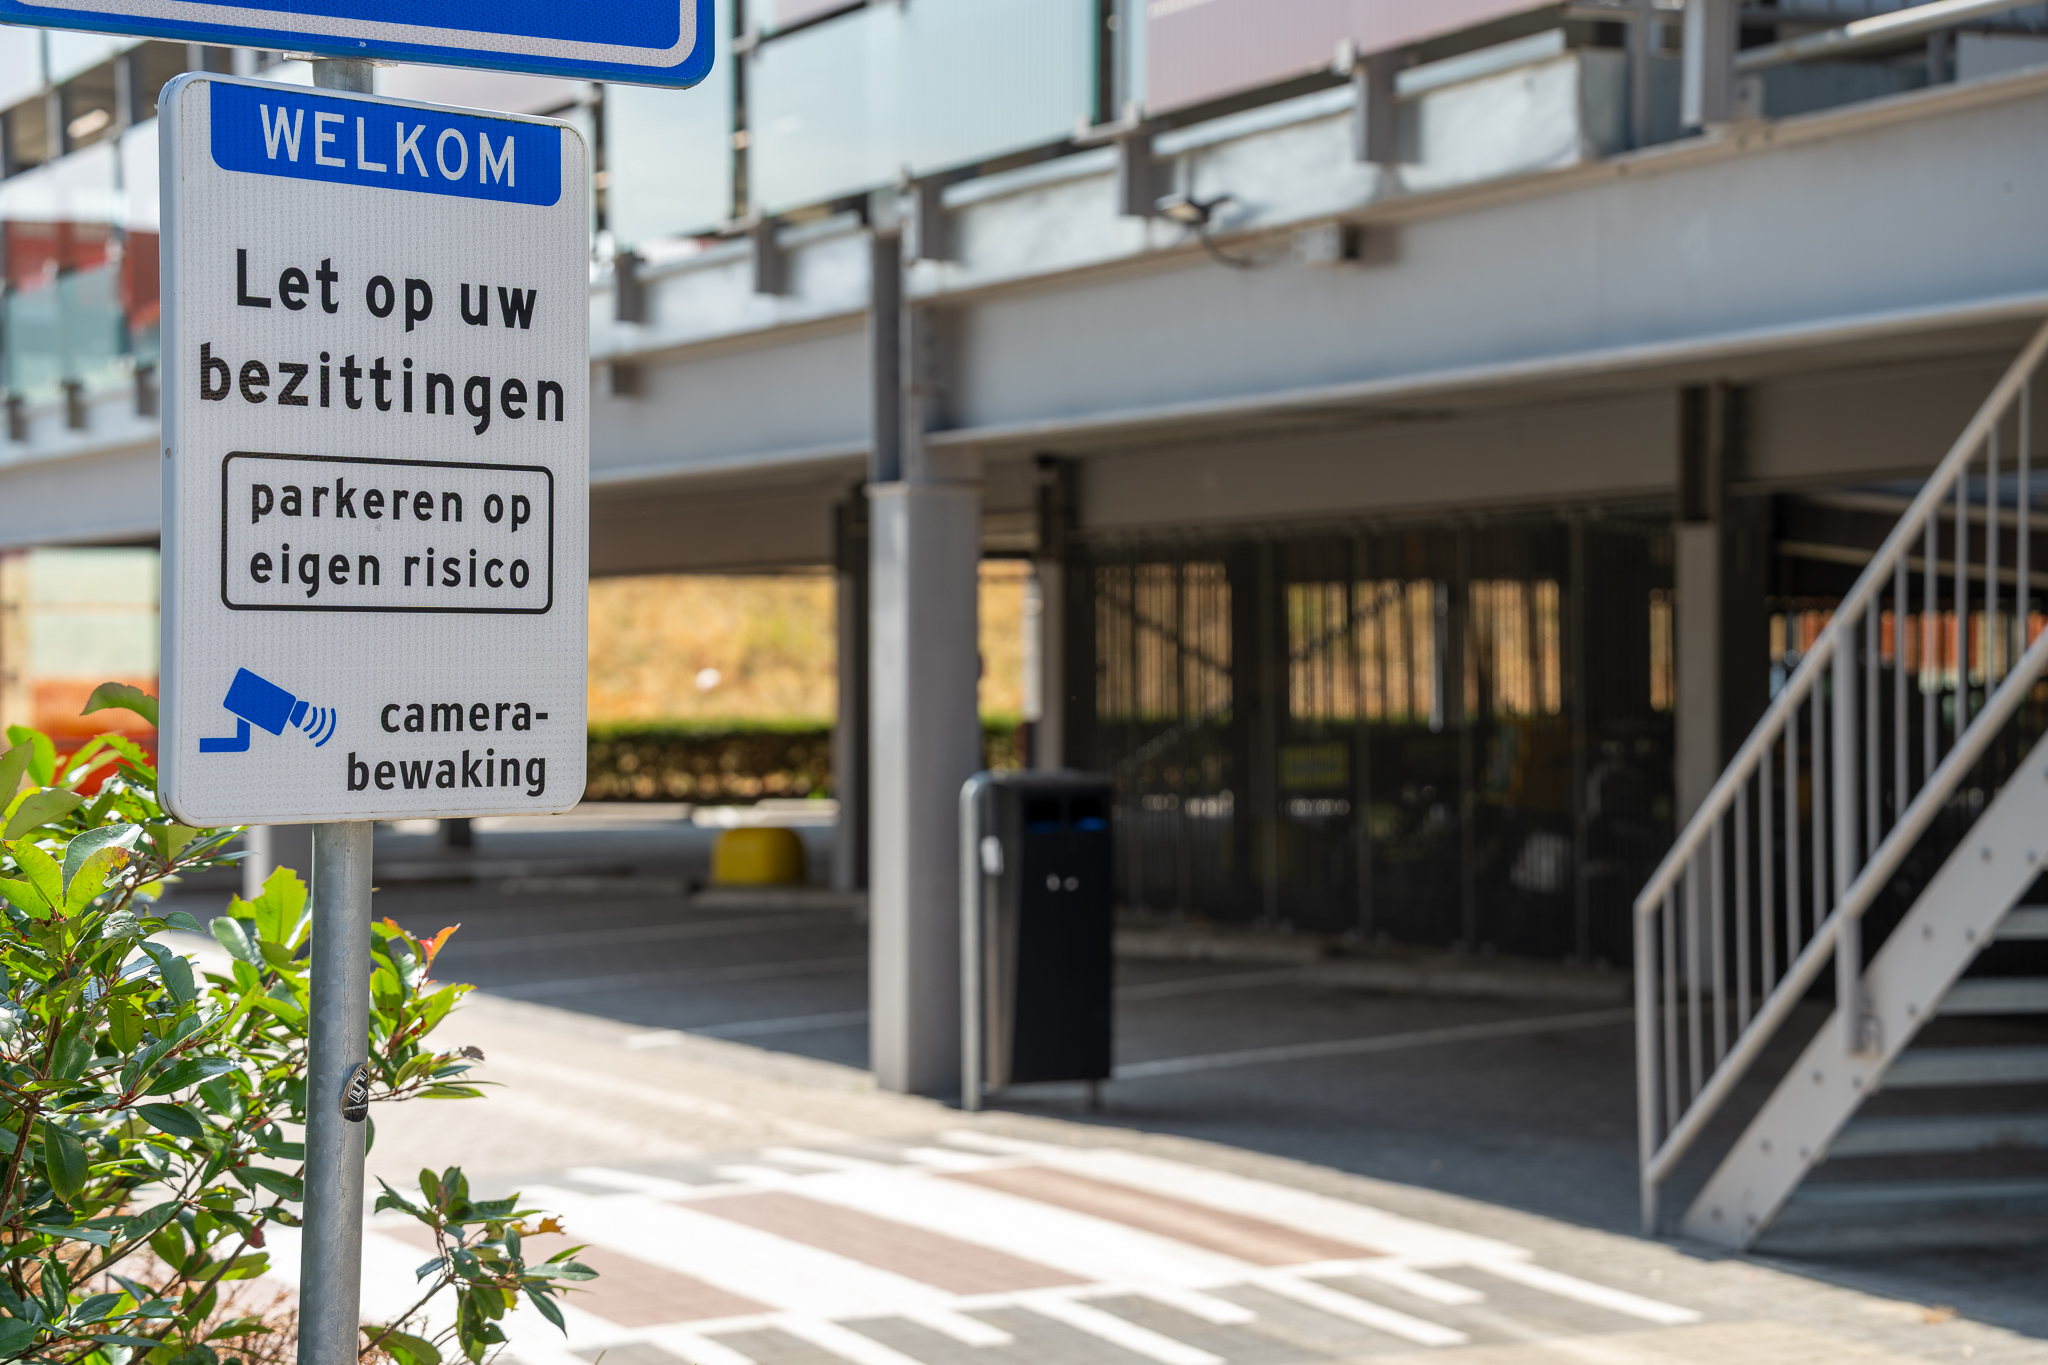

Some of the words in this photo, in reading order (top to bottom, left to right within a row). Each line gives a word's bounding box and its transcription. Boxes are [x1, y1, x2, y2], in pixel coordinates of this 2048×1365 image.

[259, 103, 516, 188] WELKOM
[236, 248, 340, 314] Let
[365, 275, 433, 333] op
[460, 283, 538, 330] uw
[200, 341, 564, 436] bezittingen
[251, 477, 463, 525] parkeren
[483, 493, 531, 533] op
[250, 543, 380, 599] eigen
[404, 547, 530, 589] risico
[380, 702, 549, 733] camera-
[347, 748, 546, 797] bewaking
